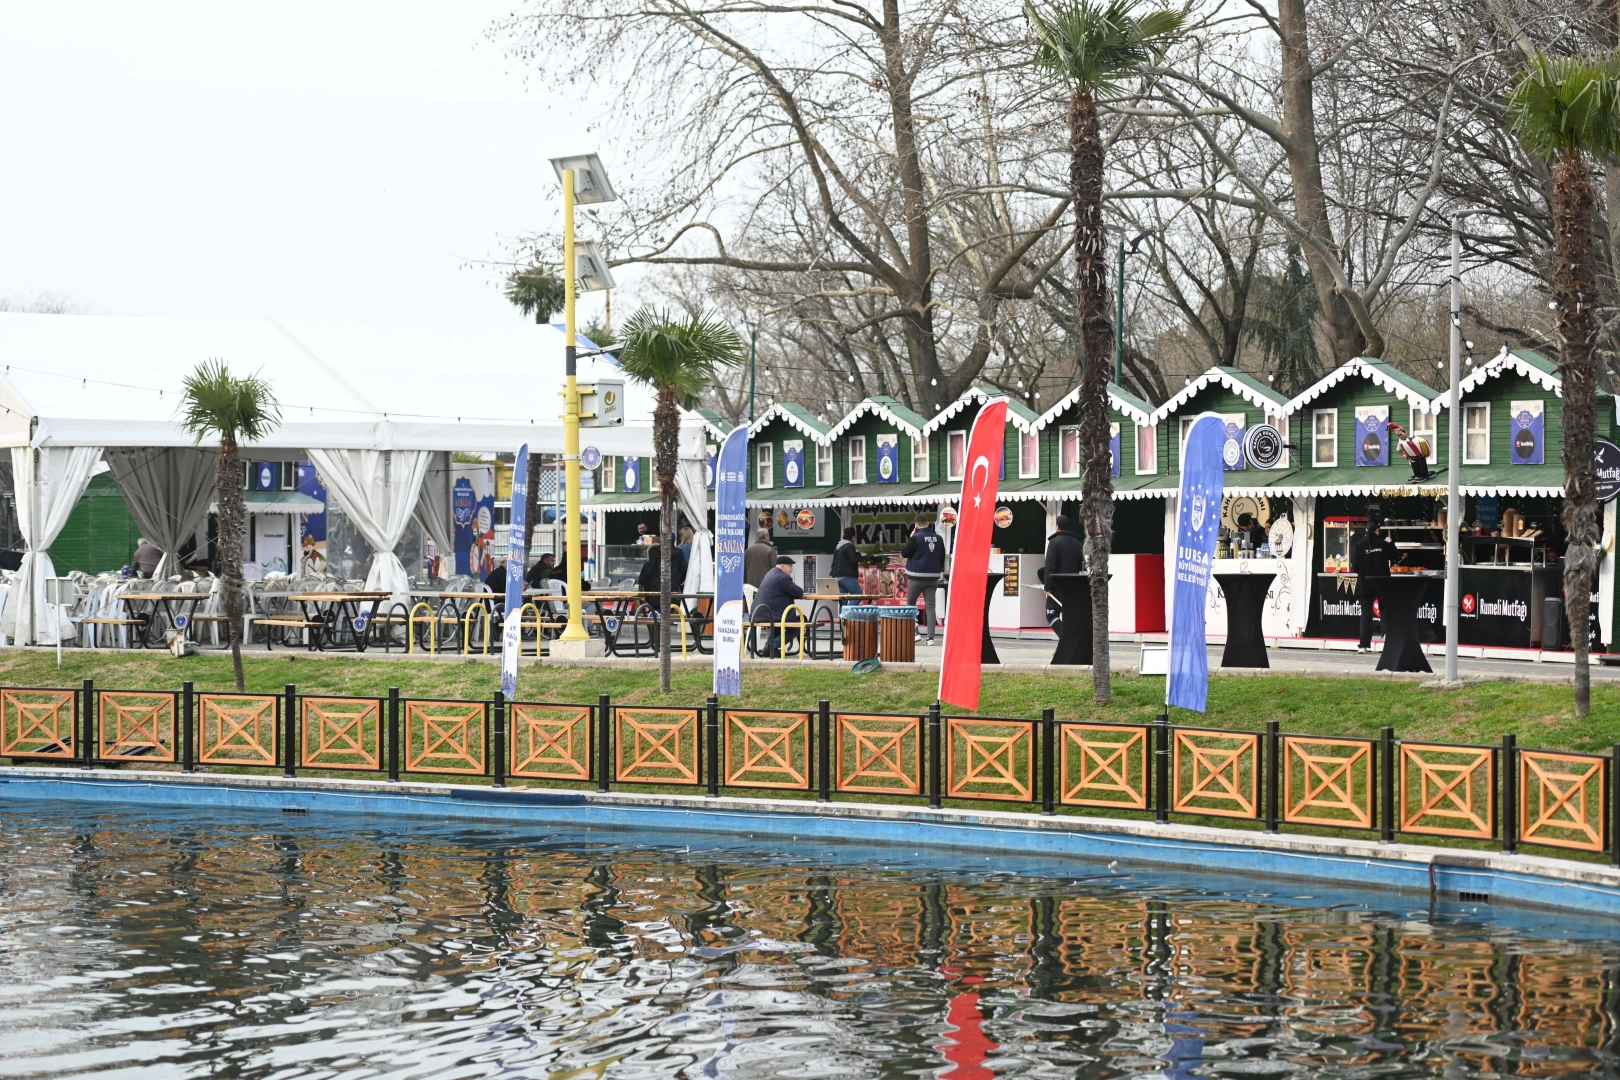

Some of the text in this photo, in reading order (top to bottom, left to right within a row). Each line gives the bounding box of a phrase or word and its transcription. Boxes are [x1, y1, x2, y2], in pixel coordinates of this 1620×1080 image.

[856, 523, 935, 546] KATM
[1179, 546, 1209, 566] BURSA
[1323, 600, 1362, 616] Rumeli Mutfa
[1417, 603, 1437, 623] utfağı
[1480, 598, 1527, 621] Rumeli Mutfağı
